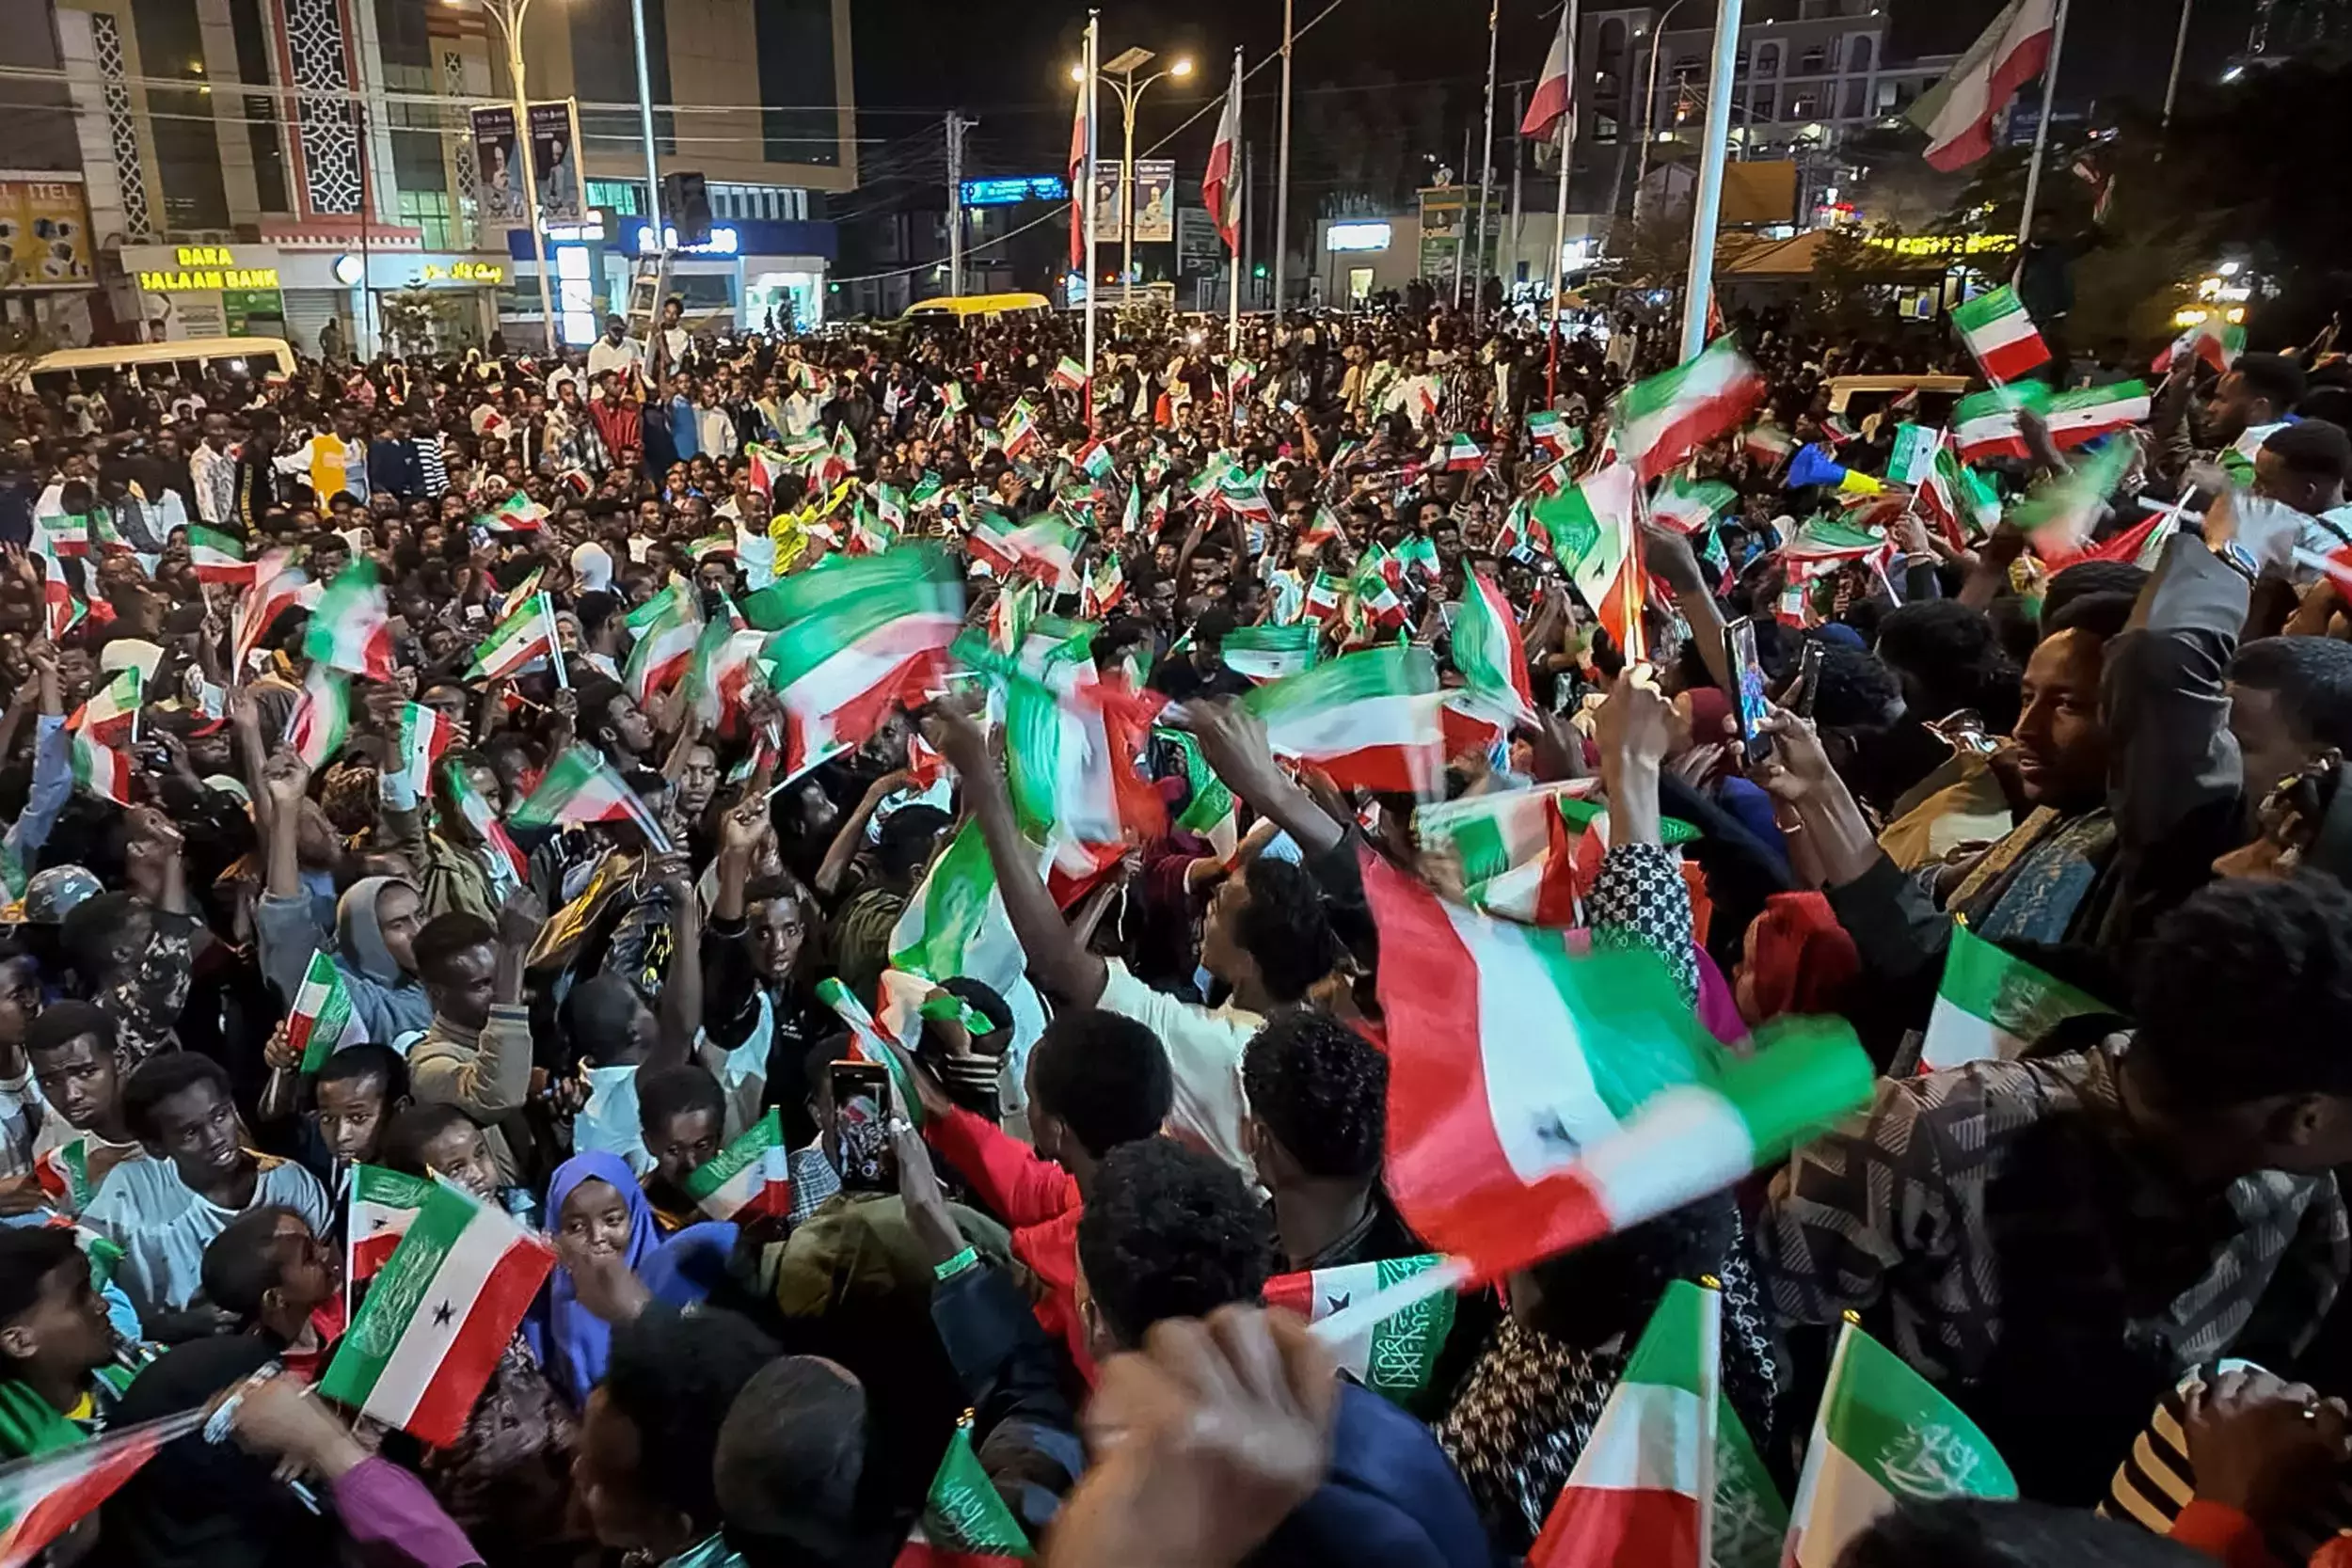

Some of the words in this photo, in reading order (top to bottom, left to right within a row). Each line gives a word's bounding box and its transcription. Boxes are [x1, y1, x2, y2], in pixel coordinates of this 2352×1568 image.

[27, 183, 75, 199] ITEL
[177, 247, 233, 266] DARA
[140, 271, 223, 290] SALAAM
[224, 269, 278, 288] BANK
